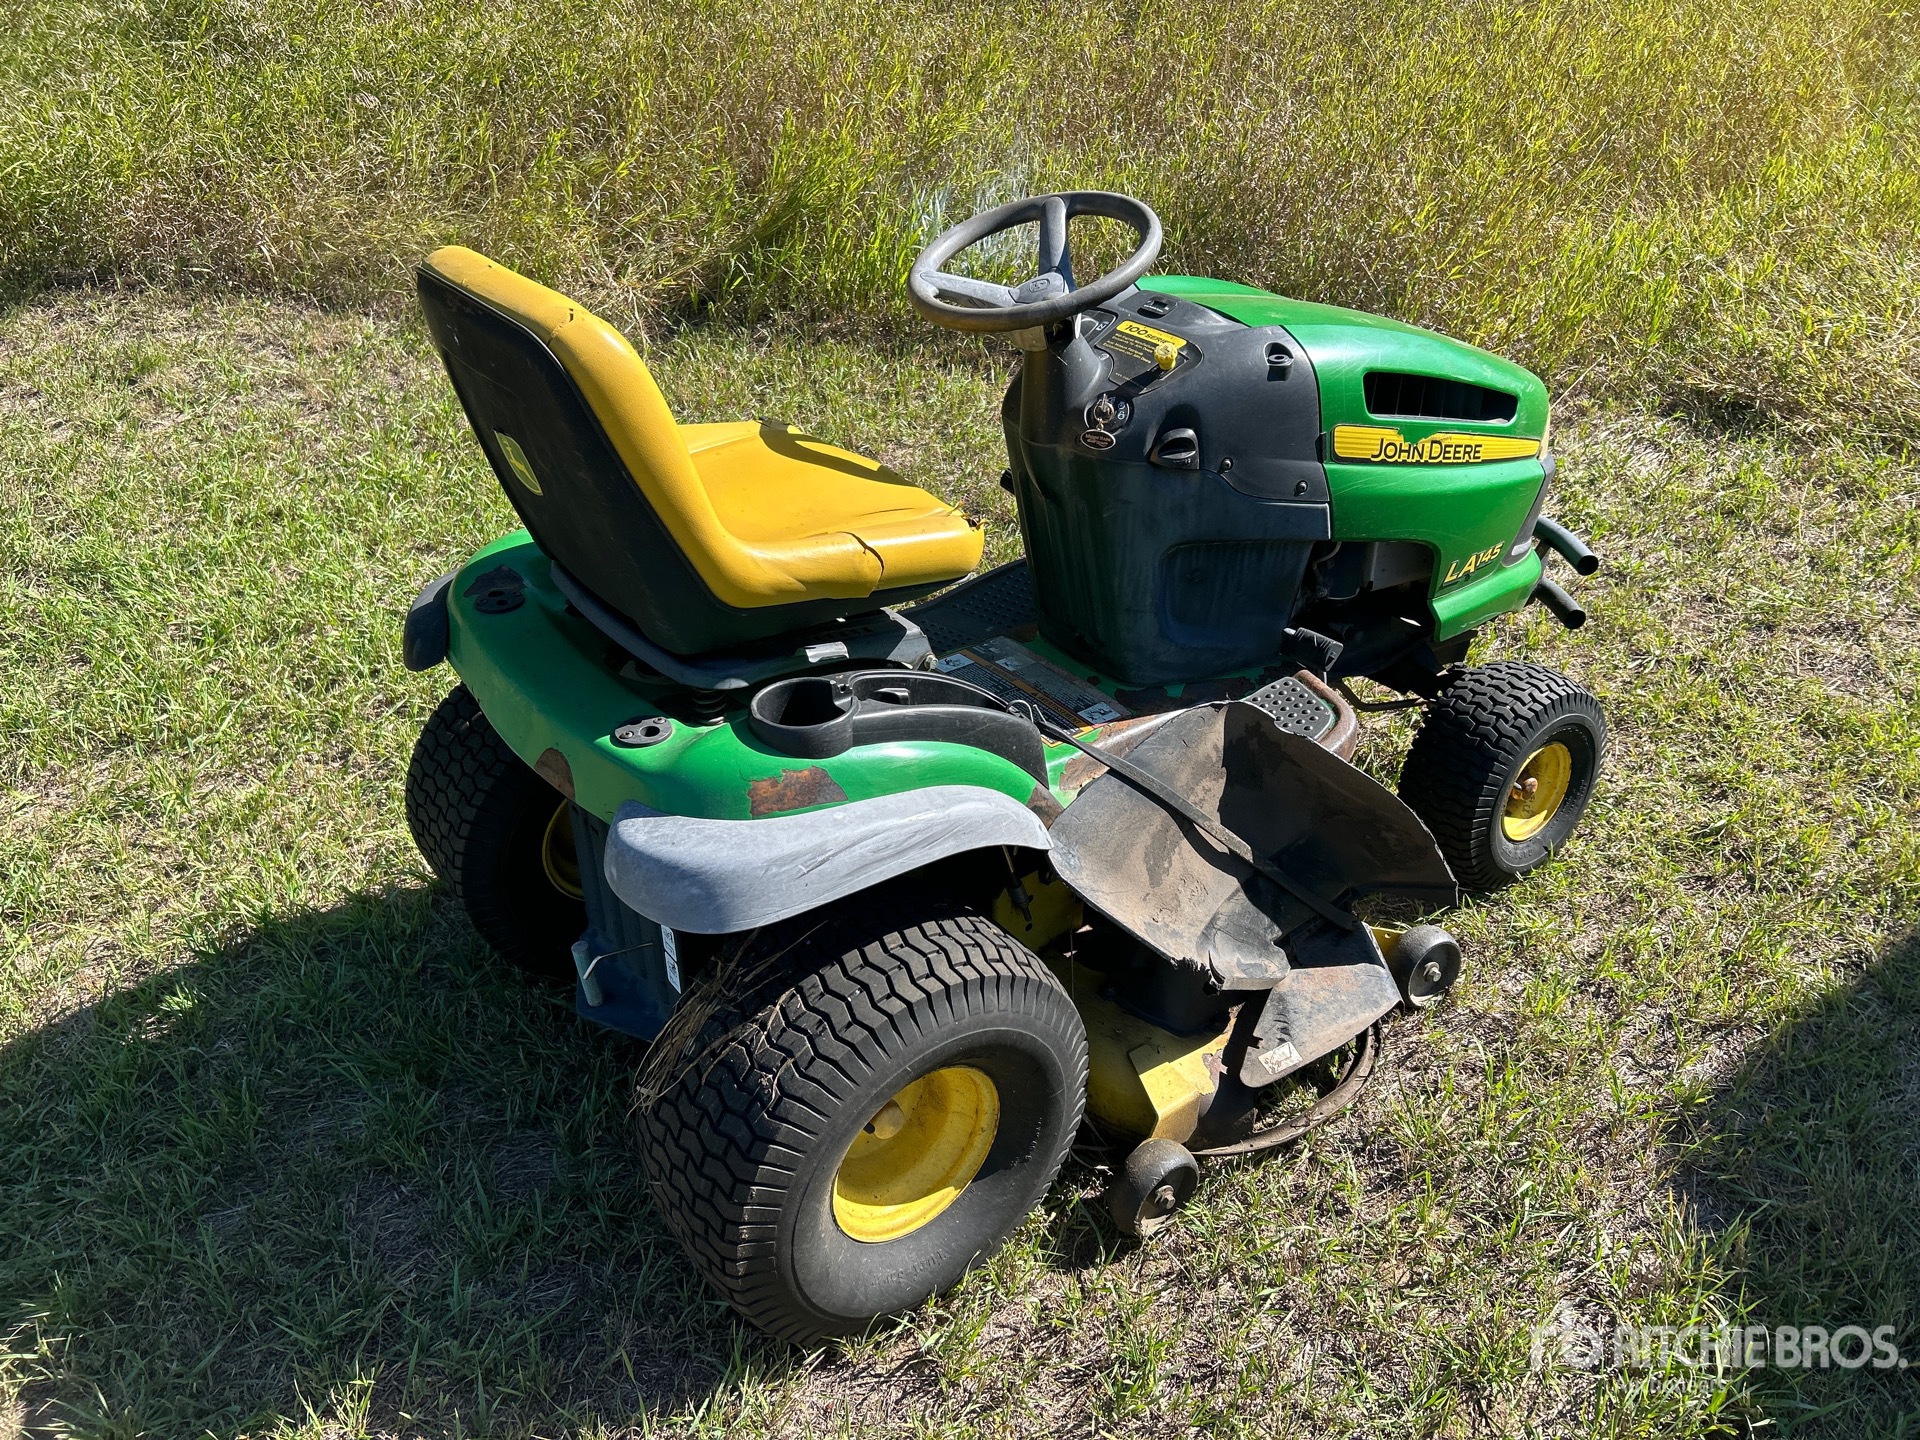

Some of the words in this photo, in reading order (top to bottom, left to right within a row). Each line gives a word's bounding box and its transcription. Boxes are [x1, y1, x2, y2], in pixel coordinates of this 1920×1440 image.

[1125, 325, 1148, 336] 100
[1371, 438, 1425, 460] JOHN
[1429, 440, 1482, 461] DEERE
[1442, 541, 1504, 586] LA145
